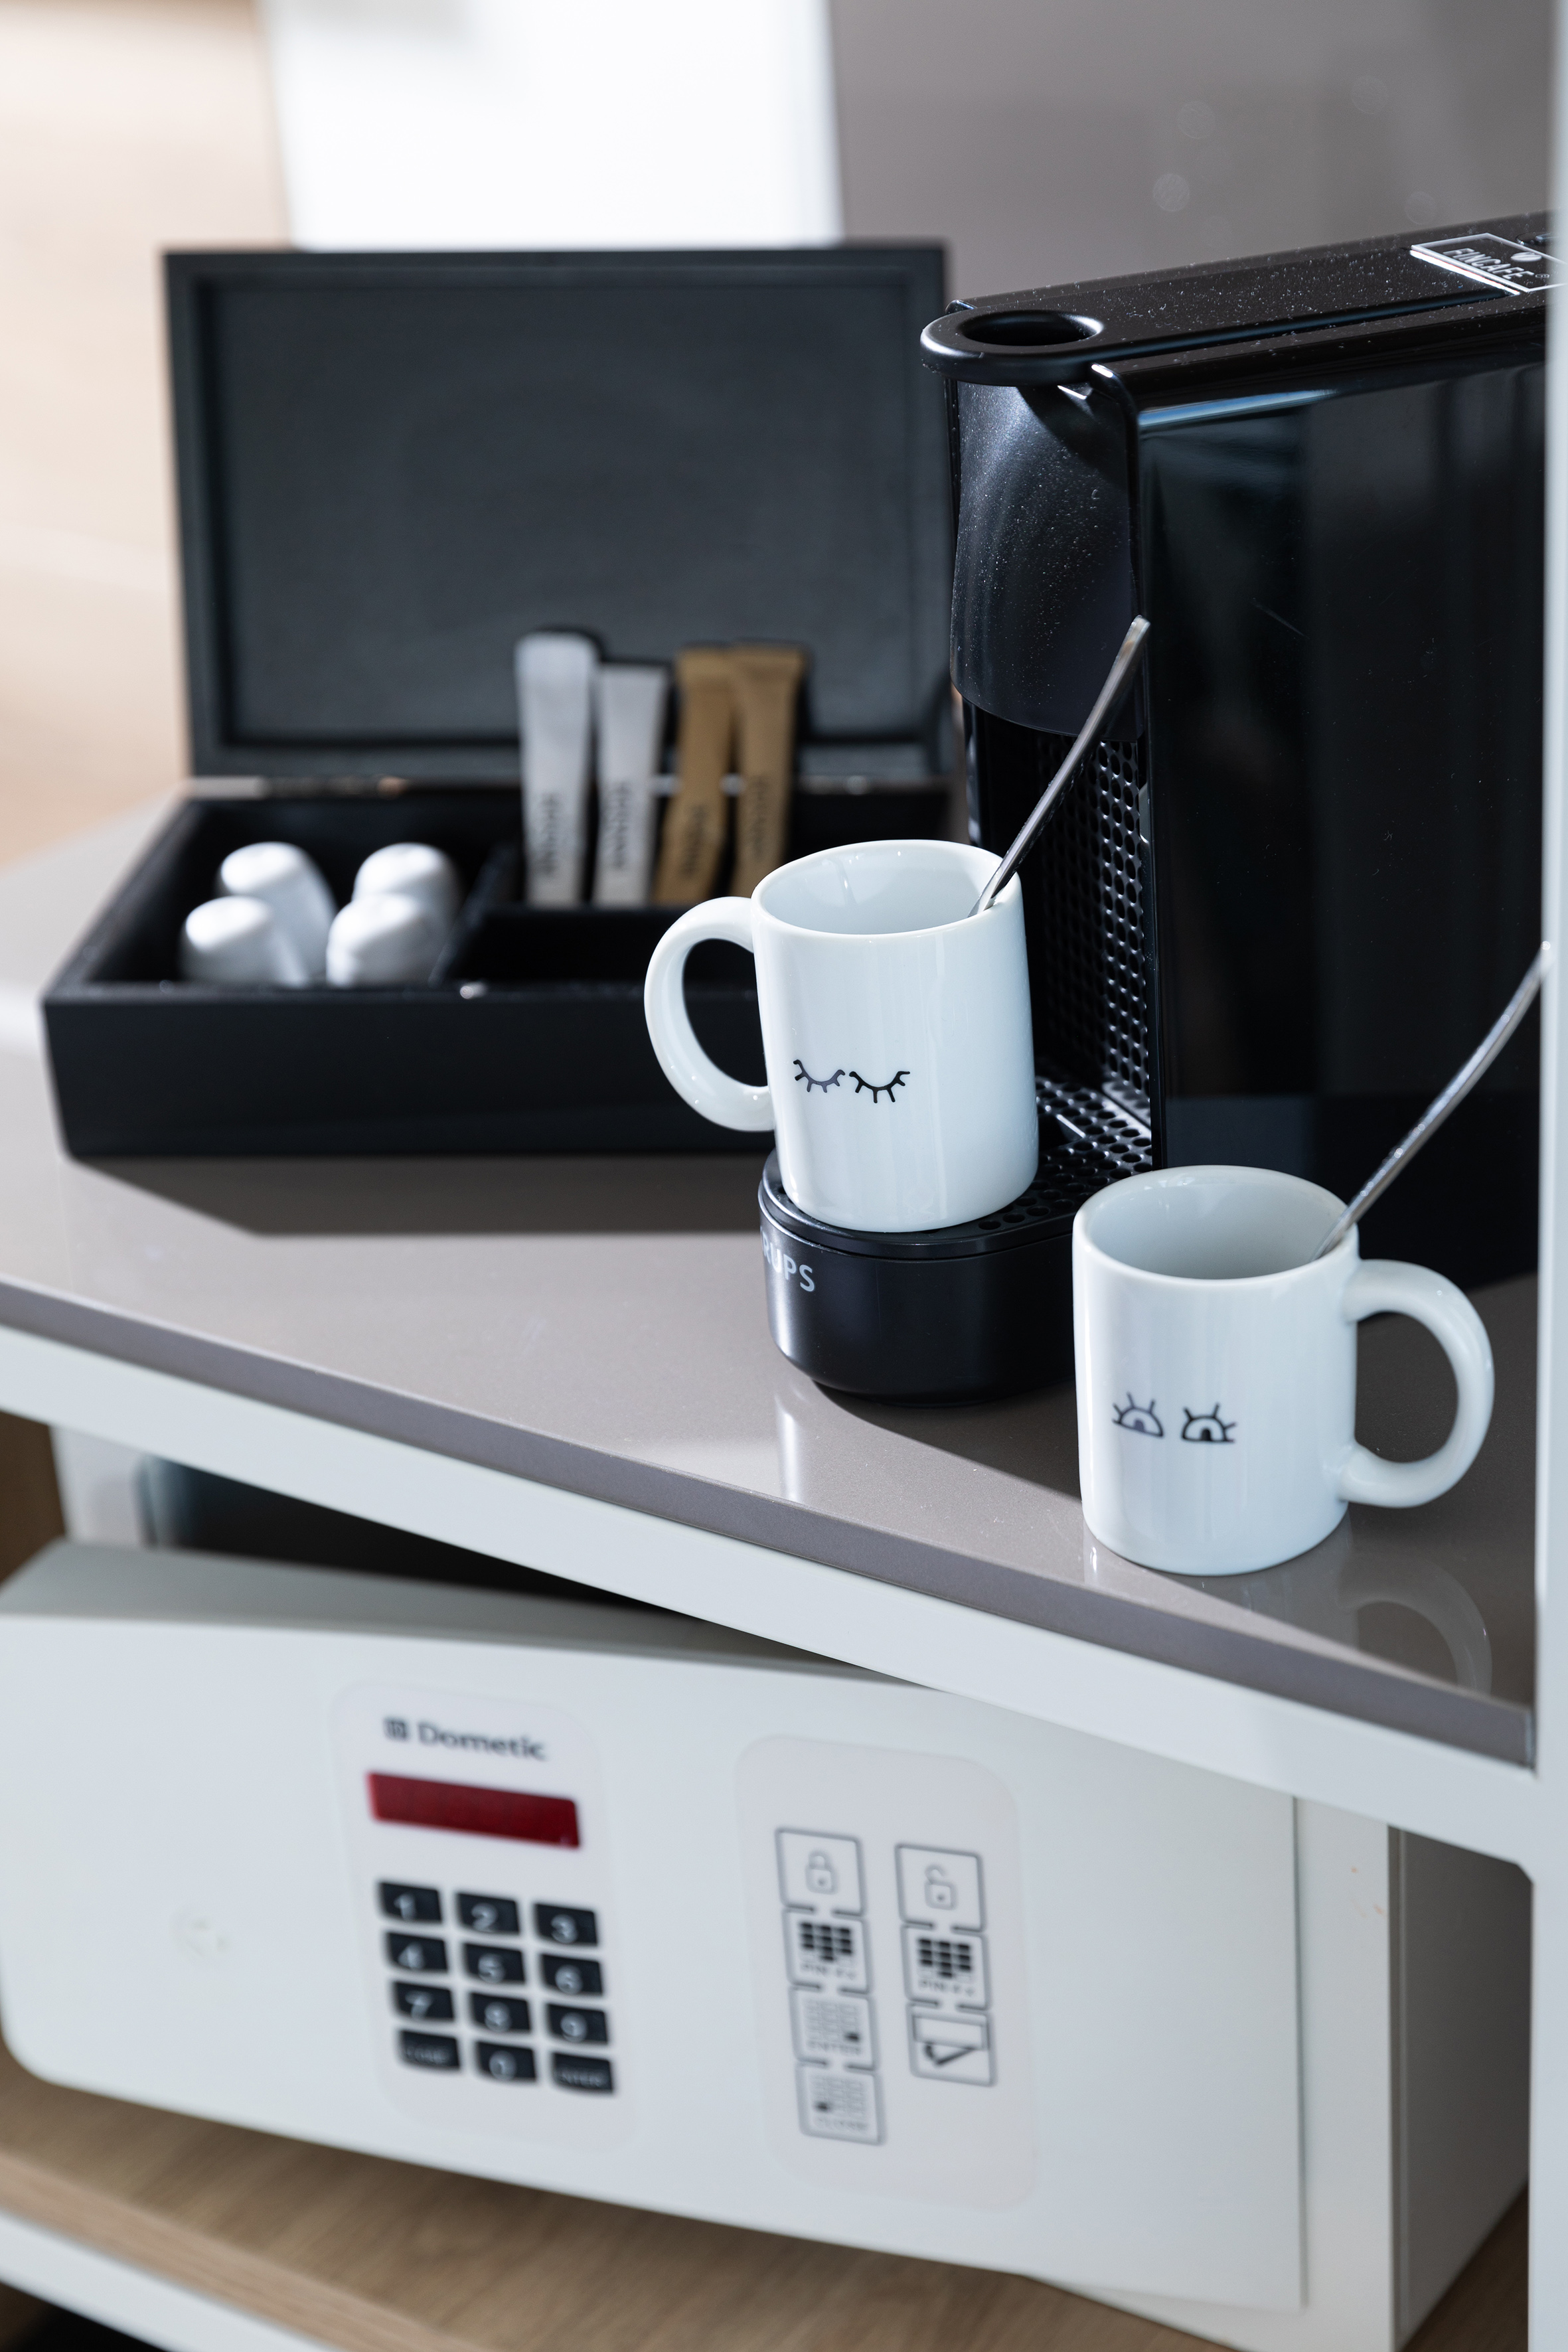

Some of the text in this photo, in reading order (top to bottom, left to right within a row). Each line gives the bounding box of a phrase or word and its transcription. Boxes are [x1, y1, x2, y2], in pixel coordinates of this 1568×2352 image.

[760, 1227, 815, 1292] RUPS
[416, 1721, 546, 1761] Dometic
[394, 1892, 579, 1944] 1 2 3
[399, 1942, 584, 1995] 4 5 6
[405, 1990, 589, 2043] 7 8 9
[489, 2050, 517, 2082] 0
